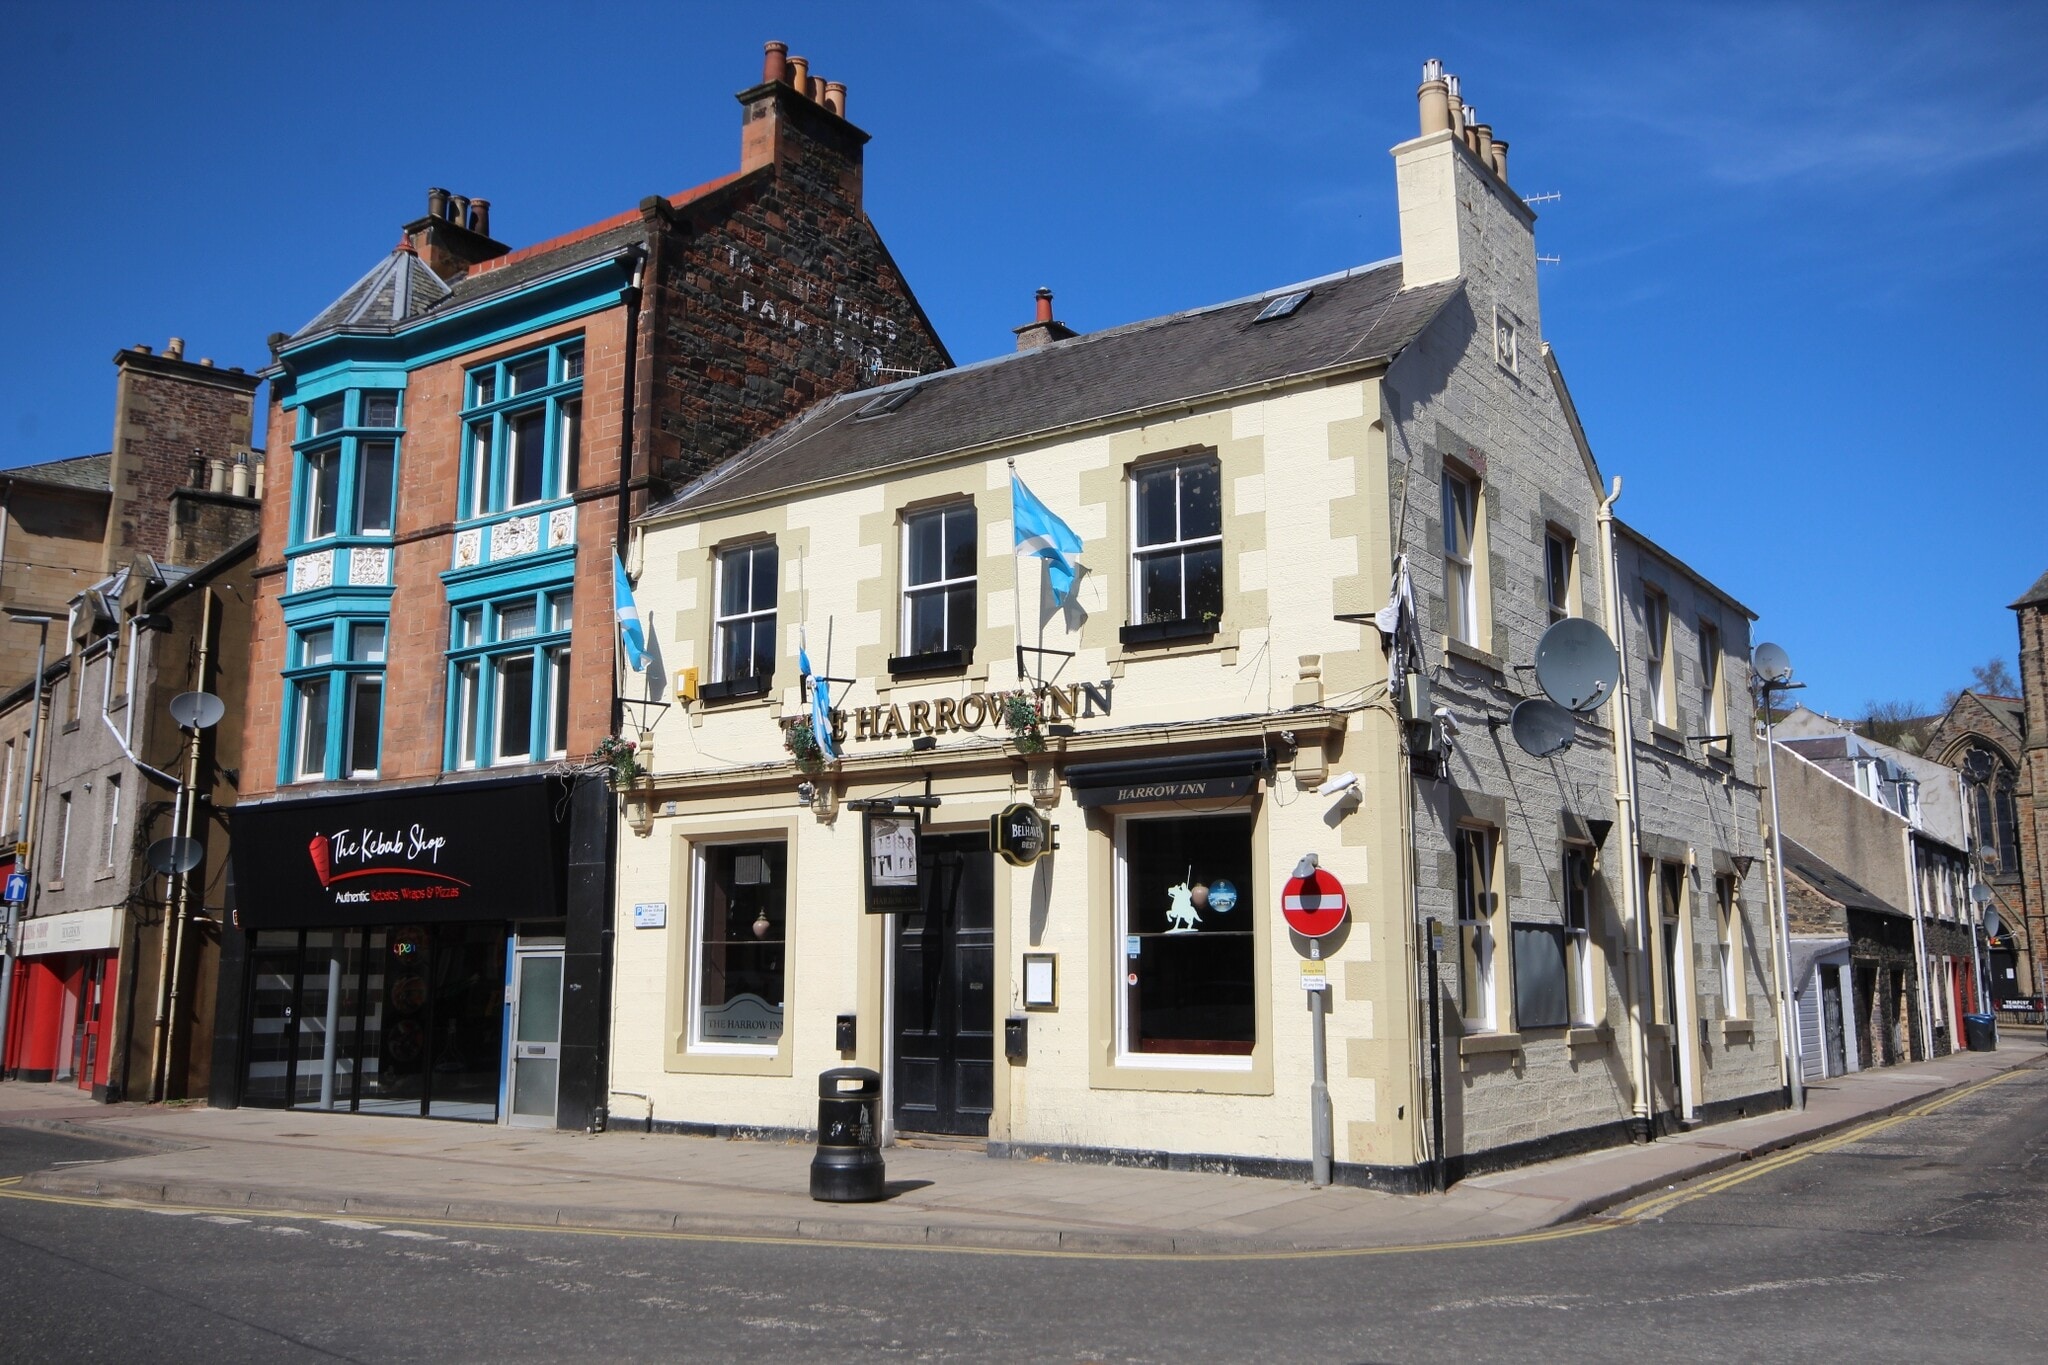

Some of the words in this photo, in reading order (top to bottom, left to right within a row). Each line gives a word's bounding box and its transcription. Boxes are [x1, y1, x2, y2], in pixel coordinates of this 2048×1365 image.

[1117, 784, 1179, 801] HARROW
[1179, 782, 1207, 794] INN
[331, 829, 360, 864] The
[361, 828, 403, 863] Kebab
[407, 823, 446, 864] Shop
[1021, 840, 1036, 849] BEST
[335, 890, 370, 903] Authentic
[401, 886, 425, 900] Wraps
[435, 885, 460, 898] Pizzas
[709, 1020, 726, 1029] THE
[727, 1020, 767, 1030] HARROW
